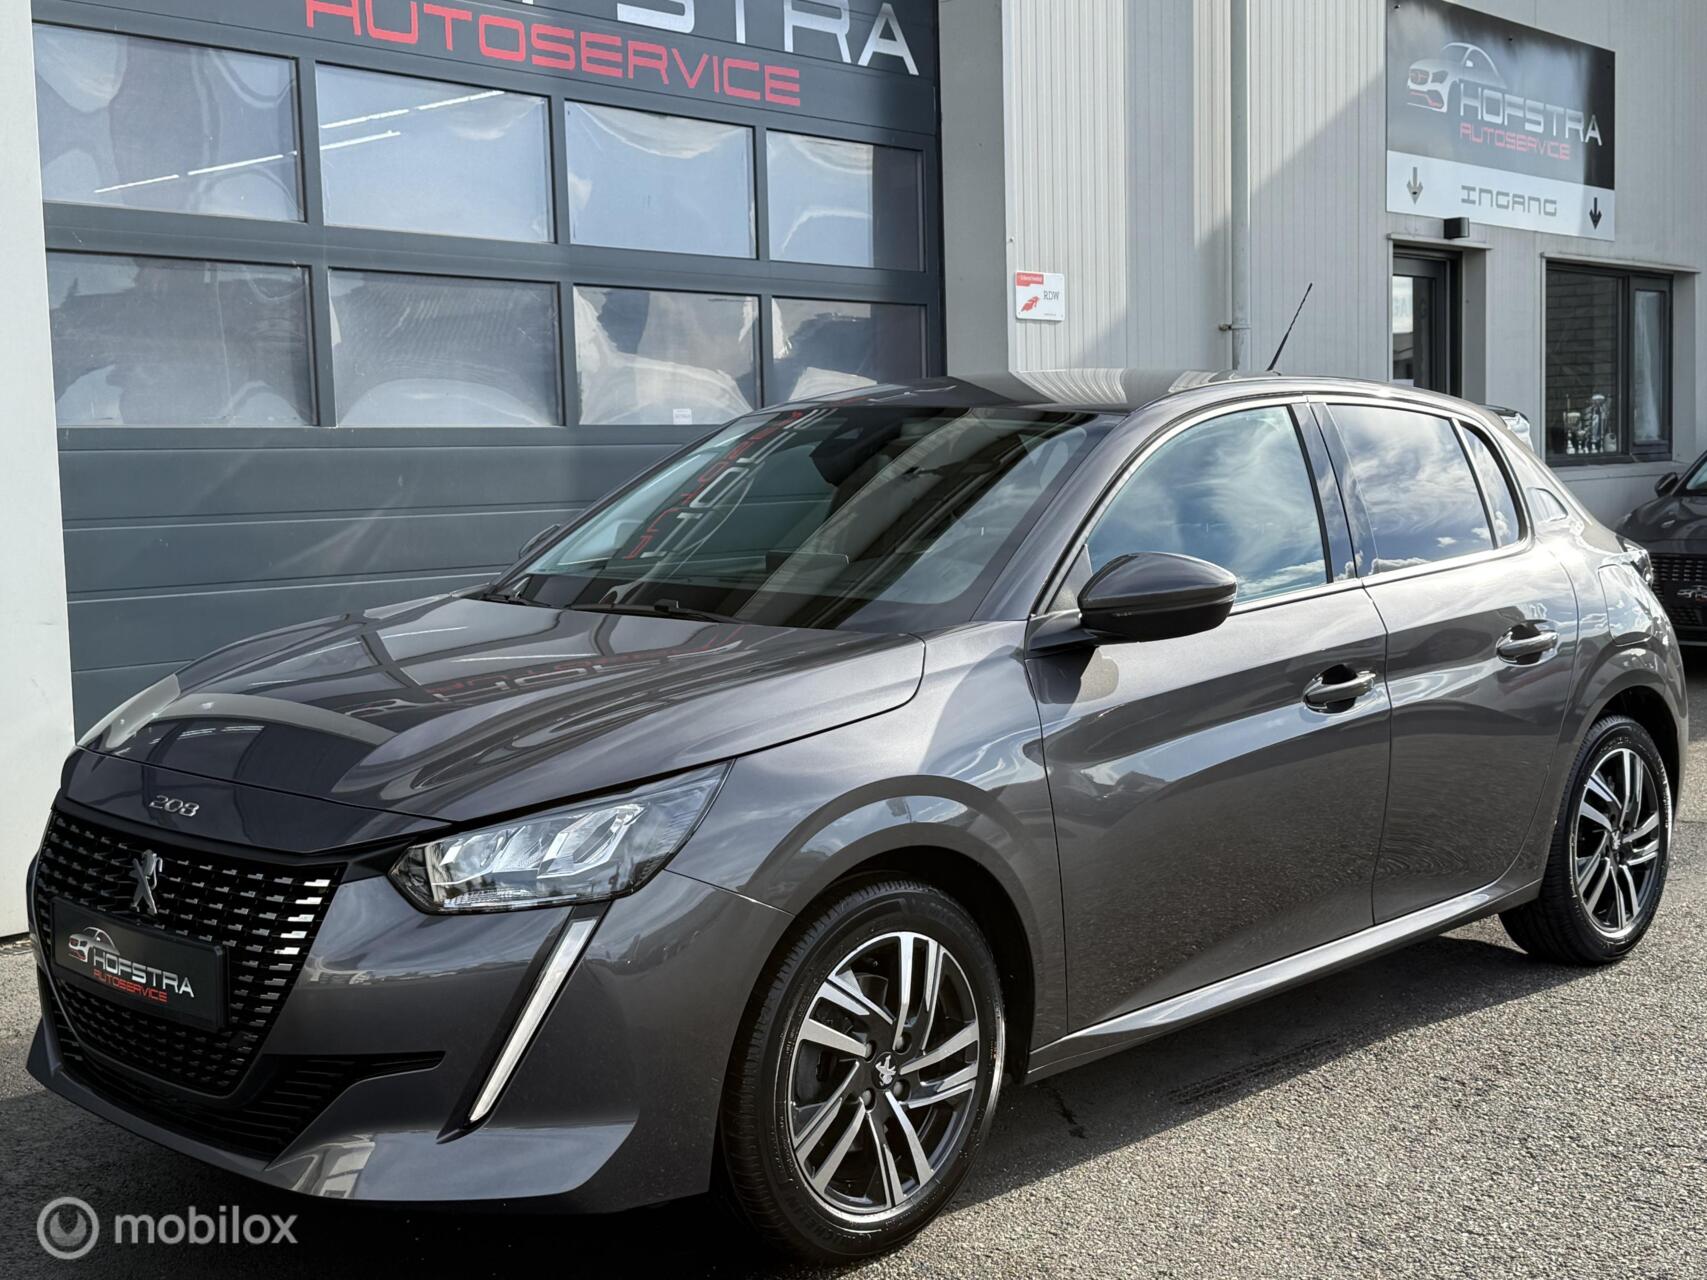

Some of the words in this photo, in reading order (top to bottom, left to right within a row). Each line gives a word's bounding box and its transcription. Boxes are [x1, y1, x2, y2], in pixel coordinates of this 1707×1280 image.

[305, 0, 800, 107] AUTOSERVICE
[1459, 82, 1602, 146] HOFSTRA
[1459, 122, 1571, 160] AUTOSERVICE
[1460, 184, 1557, 217] INGANG
[1043, 290, 1060, 301] RDW
[150, 794, 200, 818] 208
[93, 947, 195, 998] HOFSTRA
[93, 968, 168, 1003] AUTOSERVICE
